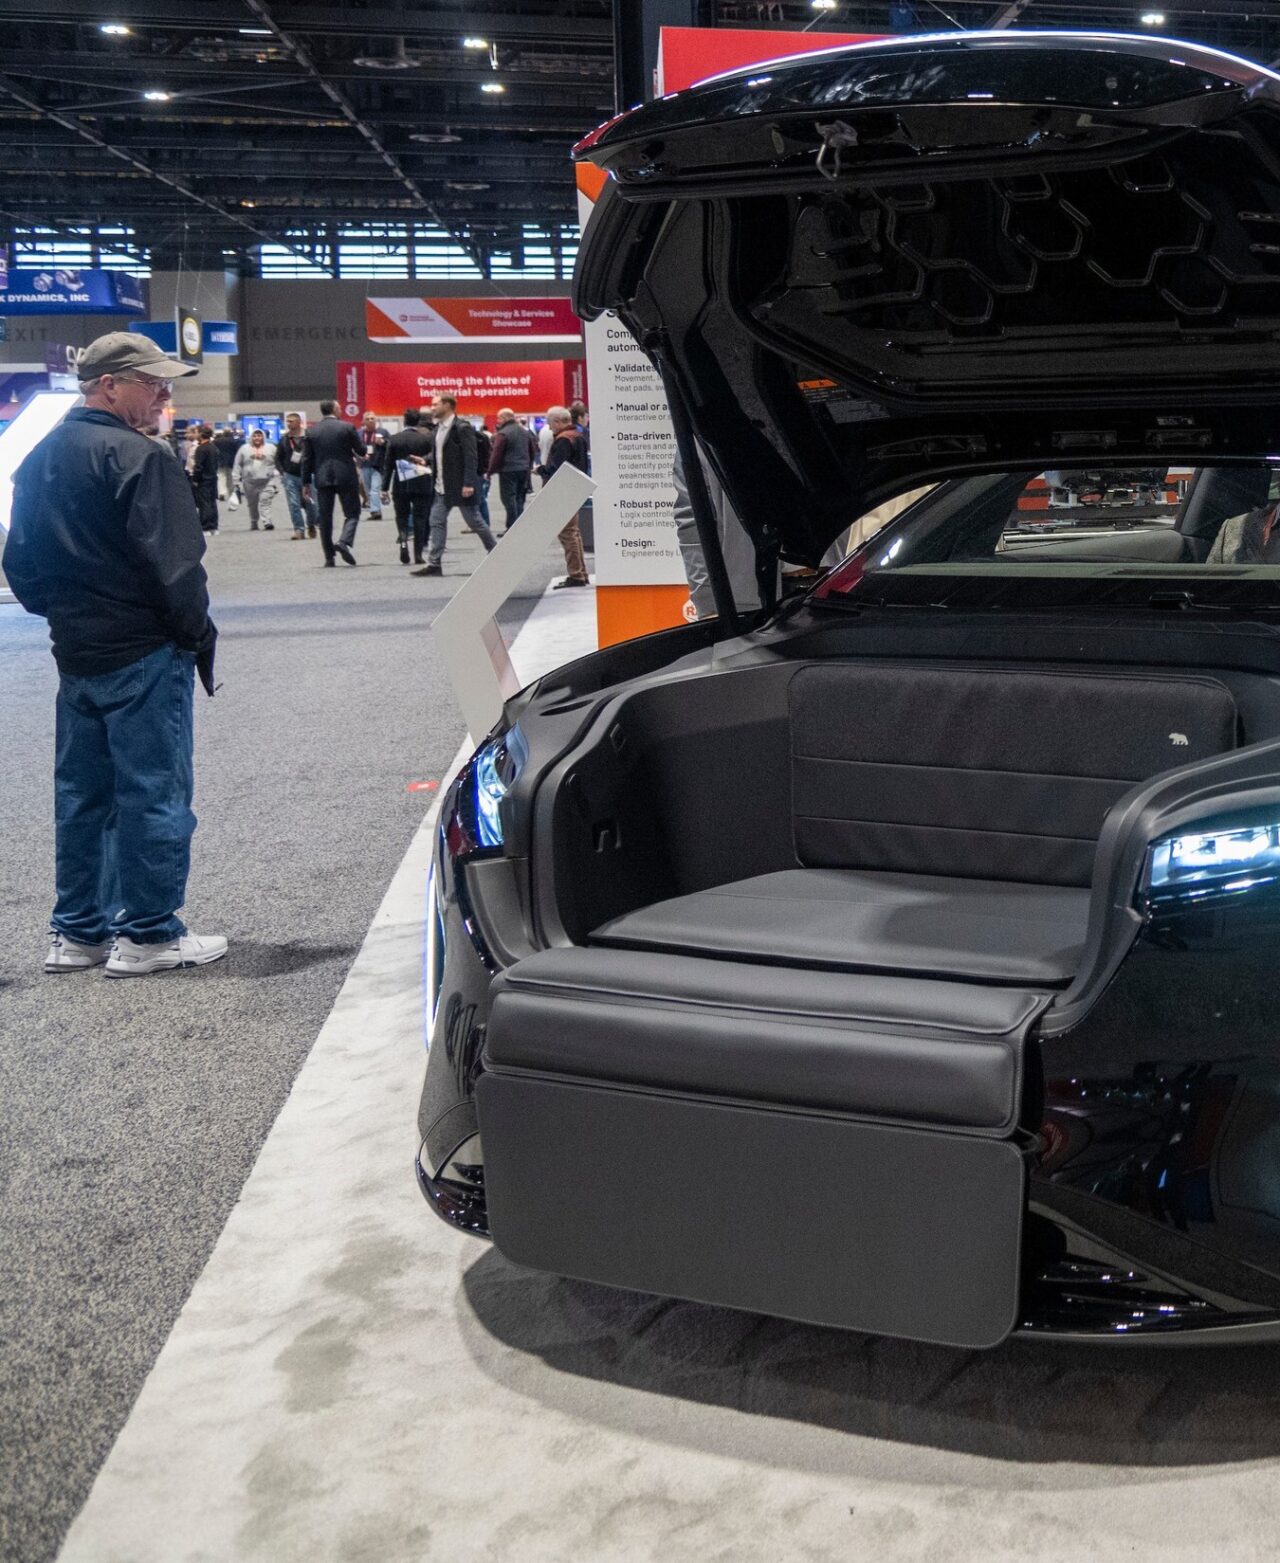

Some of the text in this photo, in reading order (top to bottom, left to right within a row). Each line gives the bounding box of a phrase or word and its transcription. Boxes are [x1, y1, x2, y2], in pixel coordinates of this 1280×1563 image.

[7, 293, 68, 303] DYNAMICS,
[70, 293, 91, 302] INC
[468, 309, 555, 320] Technology & Services
[491, 319, 532, 328] Showcase
[252, 326, 367, 340] EMERGENC
[614, 363, 656, 373] Validates
[417, 375, 531, 388] Creating the future of
[474, 386, 530, 398] operations
[615, 384, 632, 392] heat
[616, 402, 649, 412] Manual
[650, 403, 661, 411] or
[616, 414, 657, 422] Interactive
[617, 432, 672, 442] Data-driven
[617, 443, 652, 452] Captures
[627, 462, 656, 471] identify
[618, 481, 673, 491] and design tea
[620, 499, 674, 510] Robust pow
[620, 510, 640, 520] Logix
[620, 520, 632, 528] full
[633, 520, 654, 529] panel
[621, 538, 656, 549] Design:
[621, 548, 664, 559] Engineered
[665, 548, 674, 559] by
